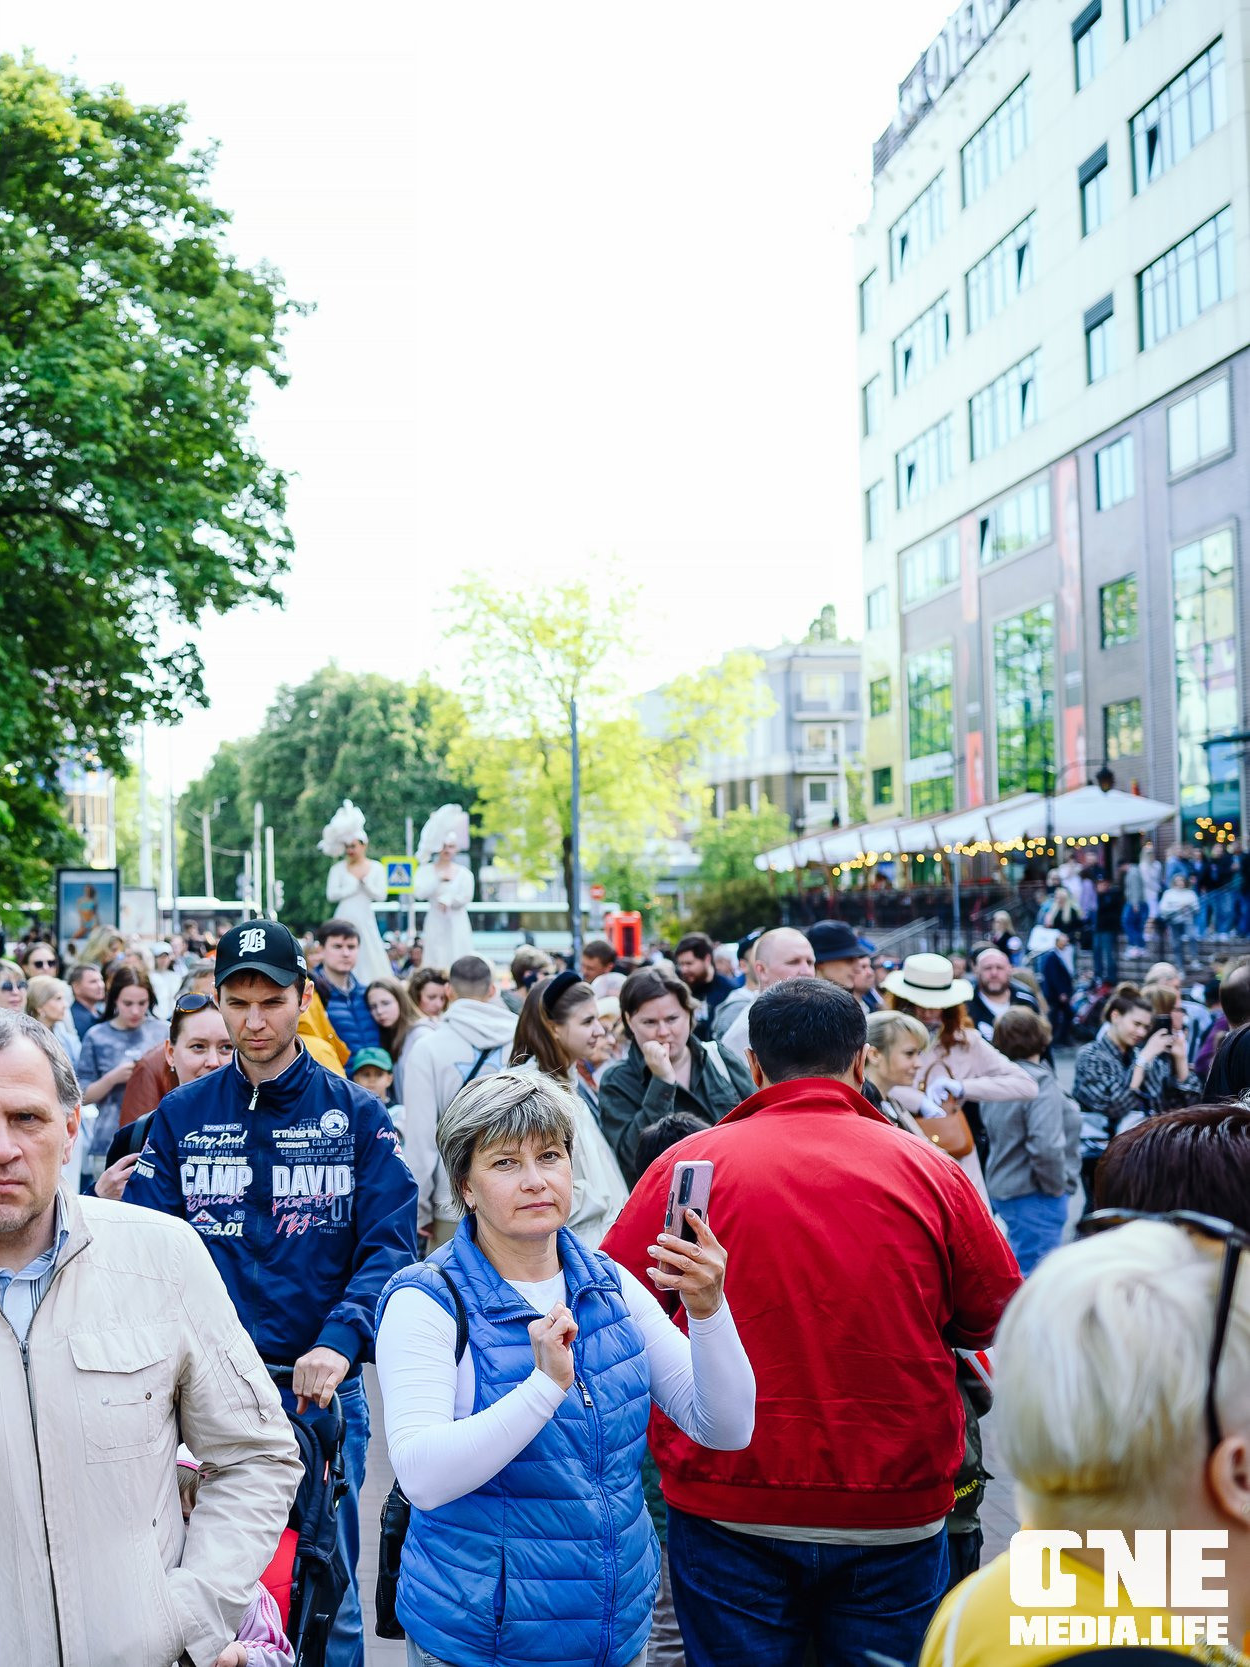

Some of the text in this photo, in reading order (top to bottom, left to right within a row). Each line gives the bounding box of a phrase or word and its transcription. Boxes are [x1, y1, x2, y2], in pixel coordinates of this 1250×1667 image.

[312, 1139, 332, 1147] CAMP
[180, 1163, 253, 1196] CAMP
[272, 1164, 352, 1197] DAVID
